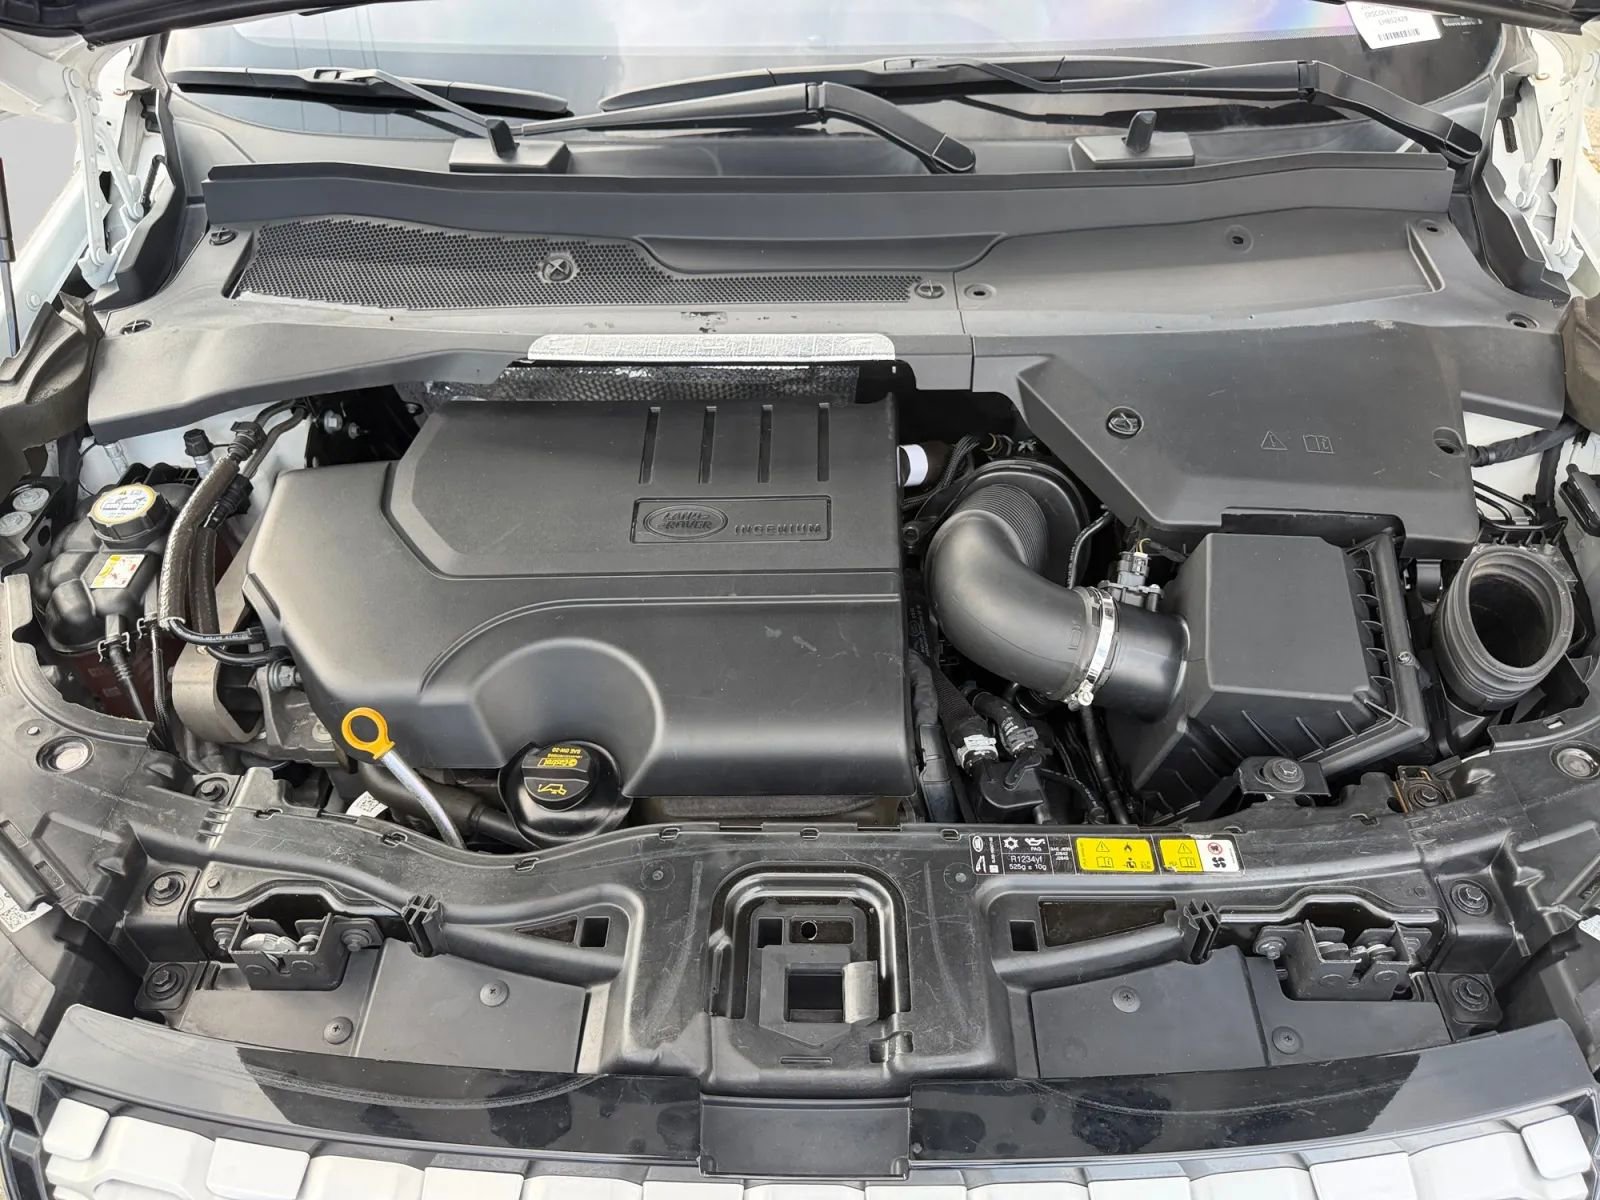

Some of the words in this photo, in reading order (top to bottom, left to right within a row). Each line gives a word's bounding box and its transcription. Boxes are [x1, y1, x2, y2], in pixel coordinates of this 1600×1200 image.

[663, 511, 710, 521] LAND
[664, 520, 713, 530] ROVER
[734, 523, 821, 536] INGENIUM
[1010, 855, 1043, 864] R1234yf
[1009, 863, 1026, 871] 525g
[1034, 863, 1047, 871] 10g
